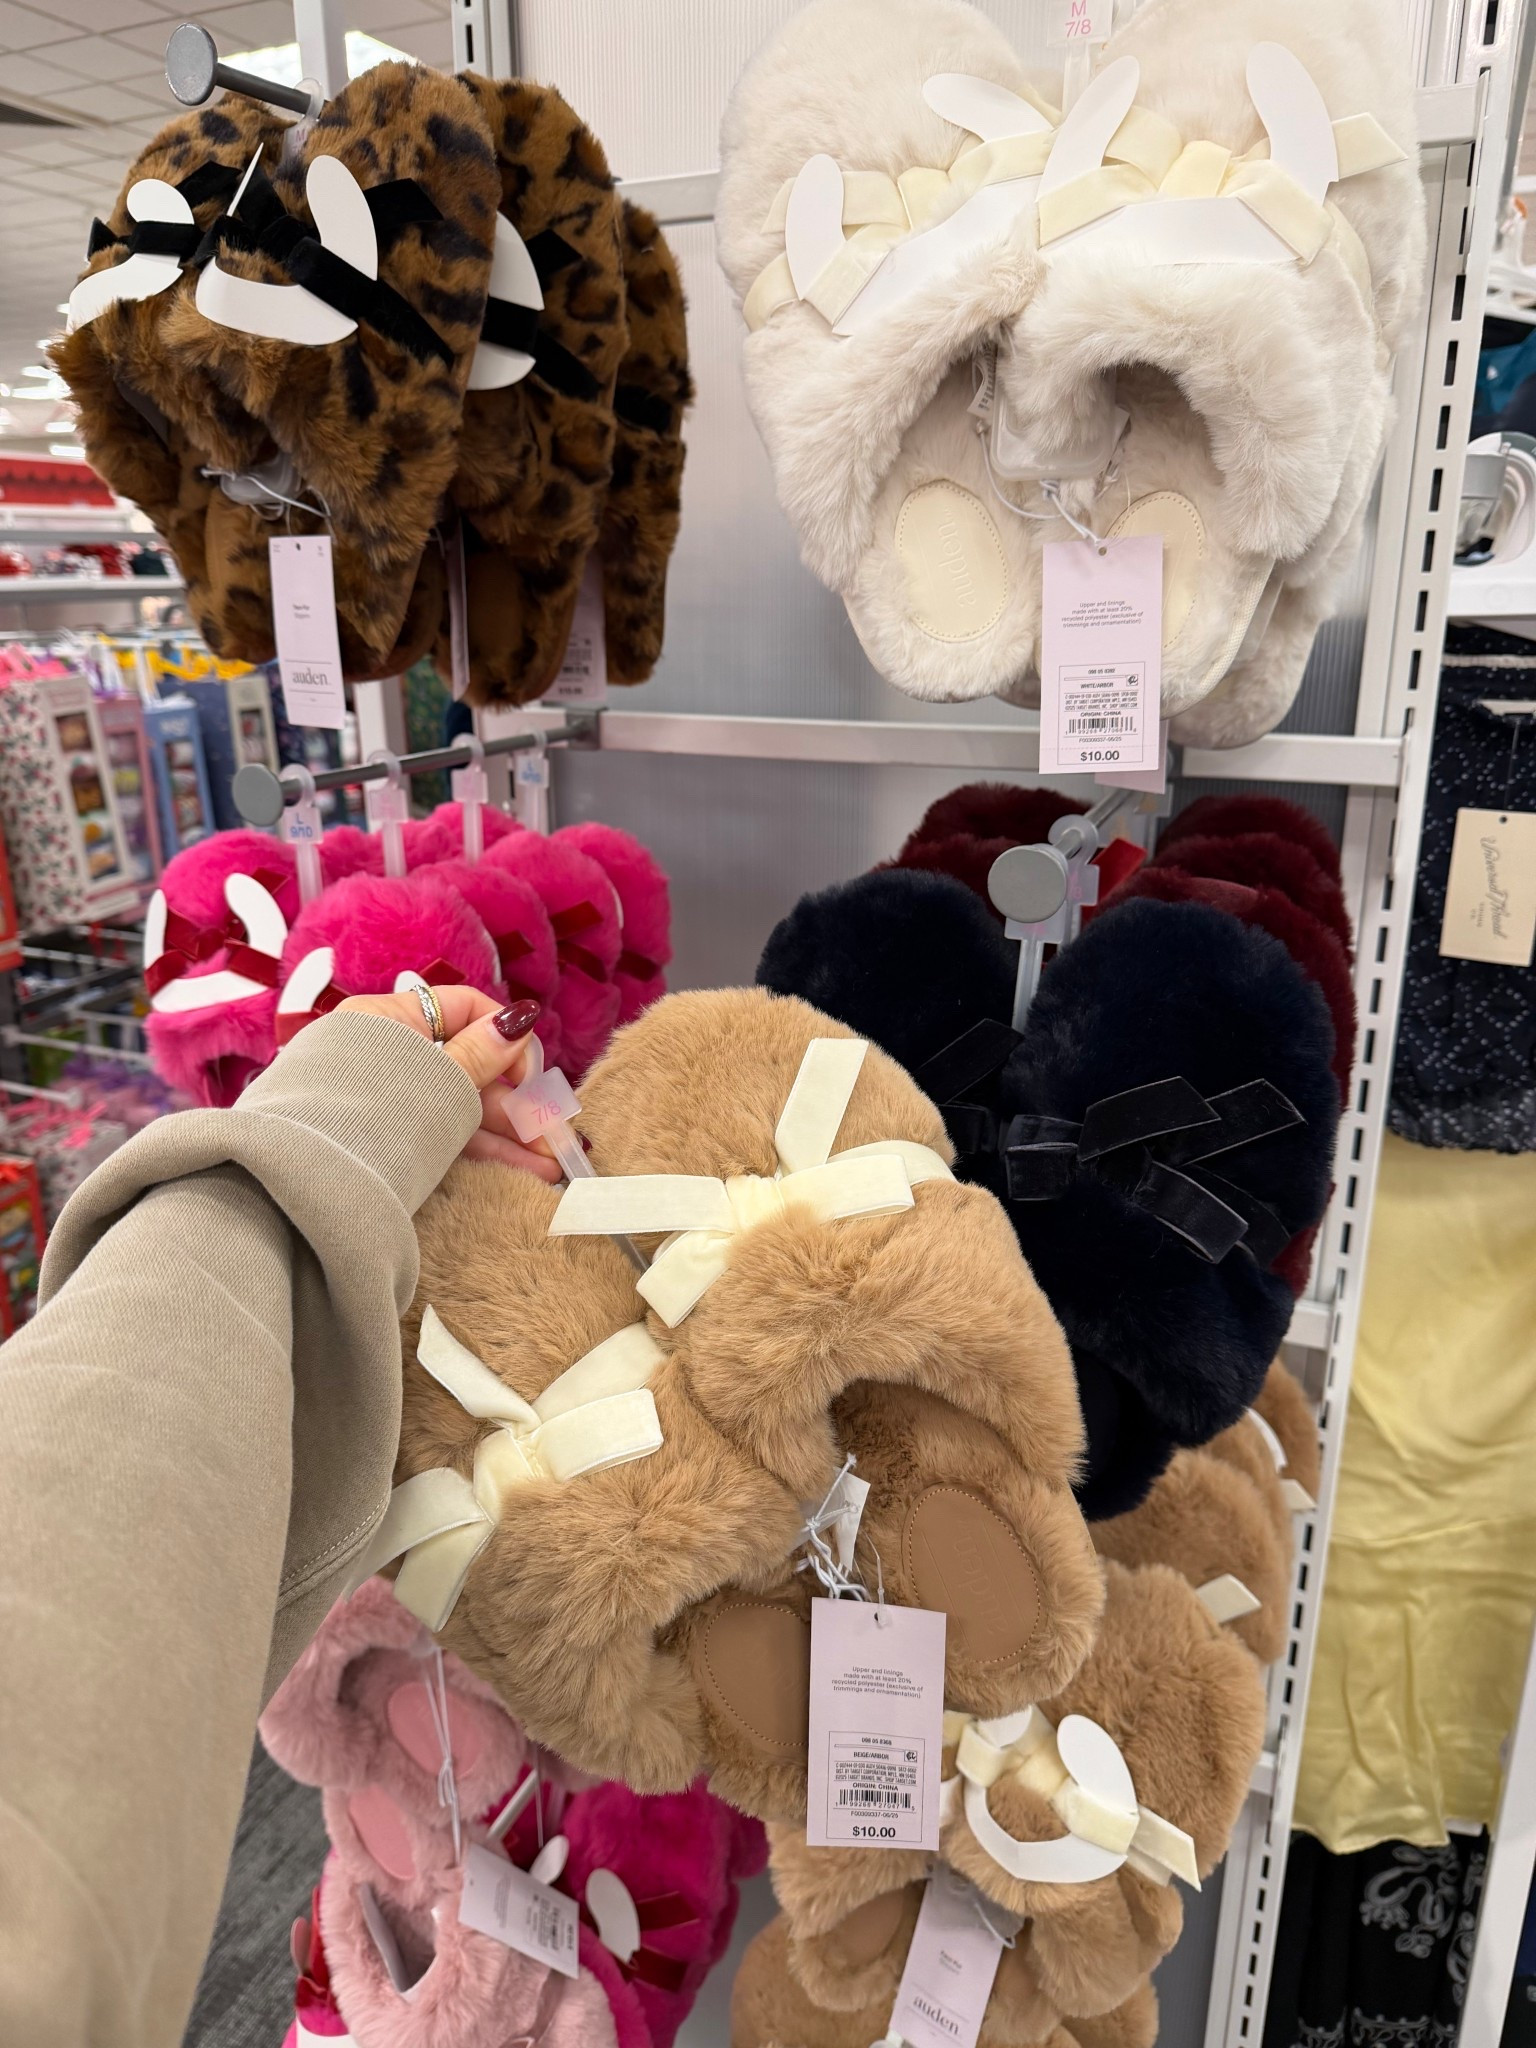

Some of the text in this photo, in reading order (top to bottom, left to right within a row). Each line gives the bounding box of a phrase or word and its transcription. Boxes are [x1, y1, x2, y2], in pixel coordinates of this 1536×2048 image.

[1065, 19, 1092, 38] 7/8
[292, 667, 328, 686] auden
[1080, 750, 1119, 761] $10.00
[531, 1100, 561, 1124] 7/8
[884, 1669, 903, 1677] linings
[886, 1683, 916, 1691] (exclusive
[876, 1689, 921, 1698] ornamentation)
[853, 1826, 896, 1838] $10.00
[913, 1996, 960, 2035] auden
